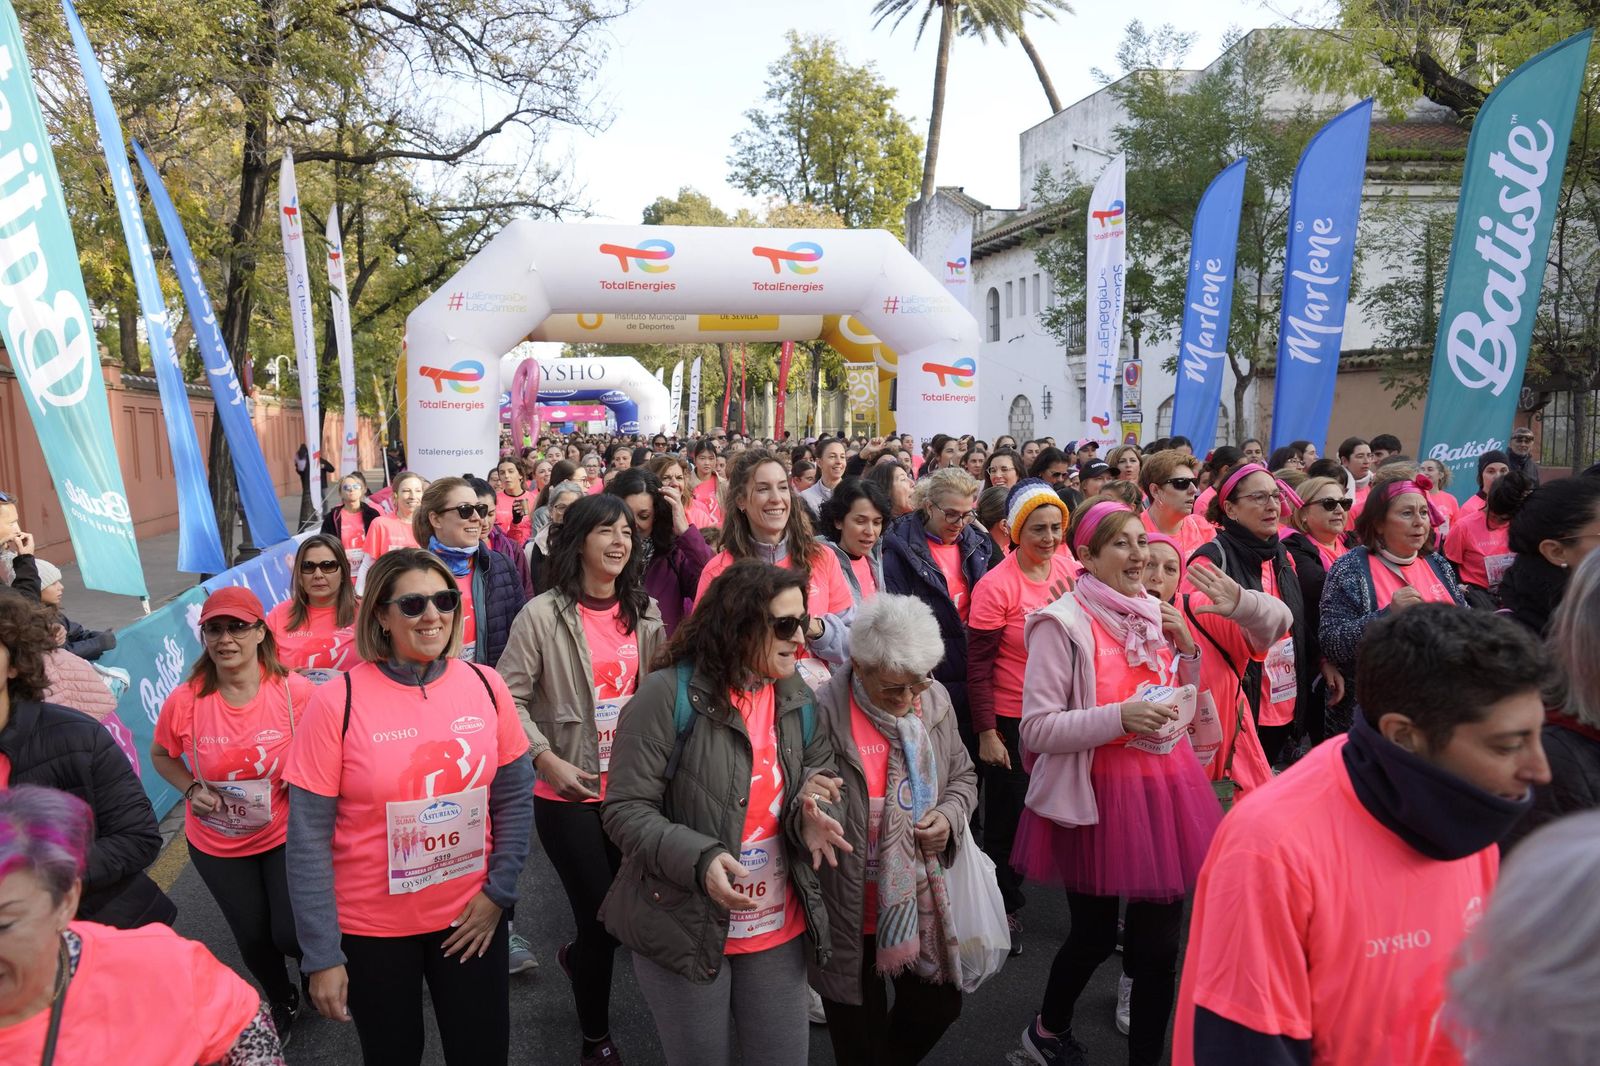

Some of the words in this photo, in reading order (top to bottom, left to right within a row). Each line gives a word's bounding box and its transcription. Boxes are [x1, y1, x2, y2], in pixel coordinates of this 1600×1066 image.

[1447, 119, 1554, 397] Batiste
[600, 280, 676, 293] TotalEnergies
[752, 281, 824, 294] TotalEnergies
[1286, 217, 1344, 365] Marlene
[614, 313, 647, 321] Instituto
[648, 313, 687, 321] Municipal
[1183, 258, 1228, 384] Marlene
[626, 322, 637, 330] de
[638, 322, 675, 331] Deportes
[540, 363, 605, 381] YSHO
[921, 393, 976, 404] TotalEnergies
[419, 400, 485, 411] TotalEnergies
[418, 447, 484, 457] totalenergies.es
[1428, 437, 1503, 462] Batiste
[373, 727, 418, 743] OYSHO
[859, 743, 885, 755] SHO
[226, 804, 247, 817] 16
[422, 808, 459, 821] ASTURIANA
[424, 831, 460, 852] 016
[433, 852, 451, 863] 5319
